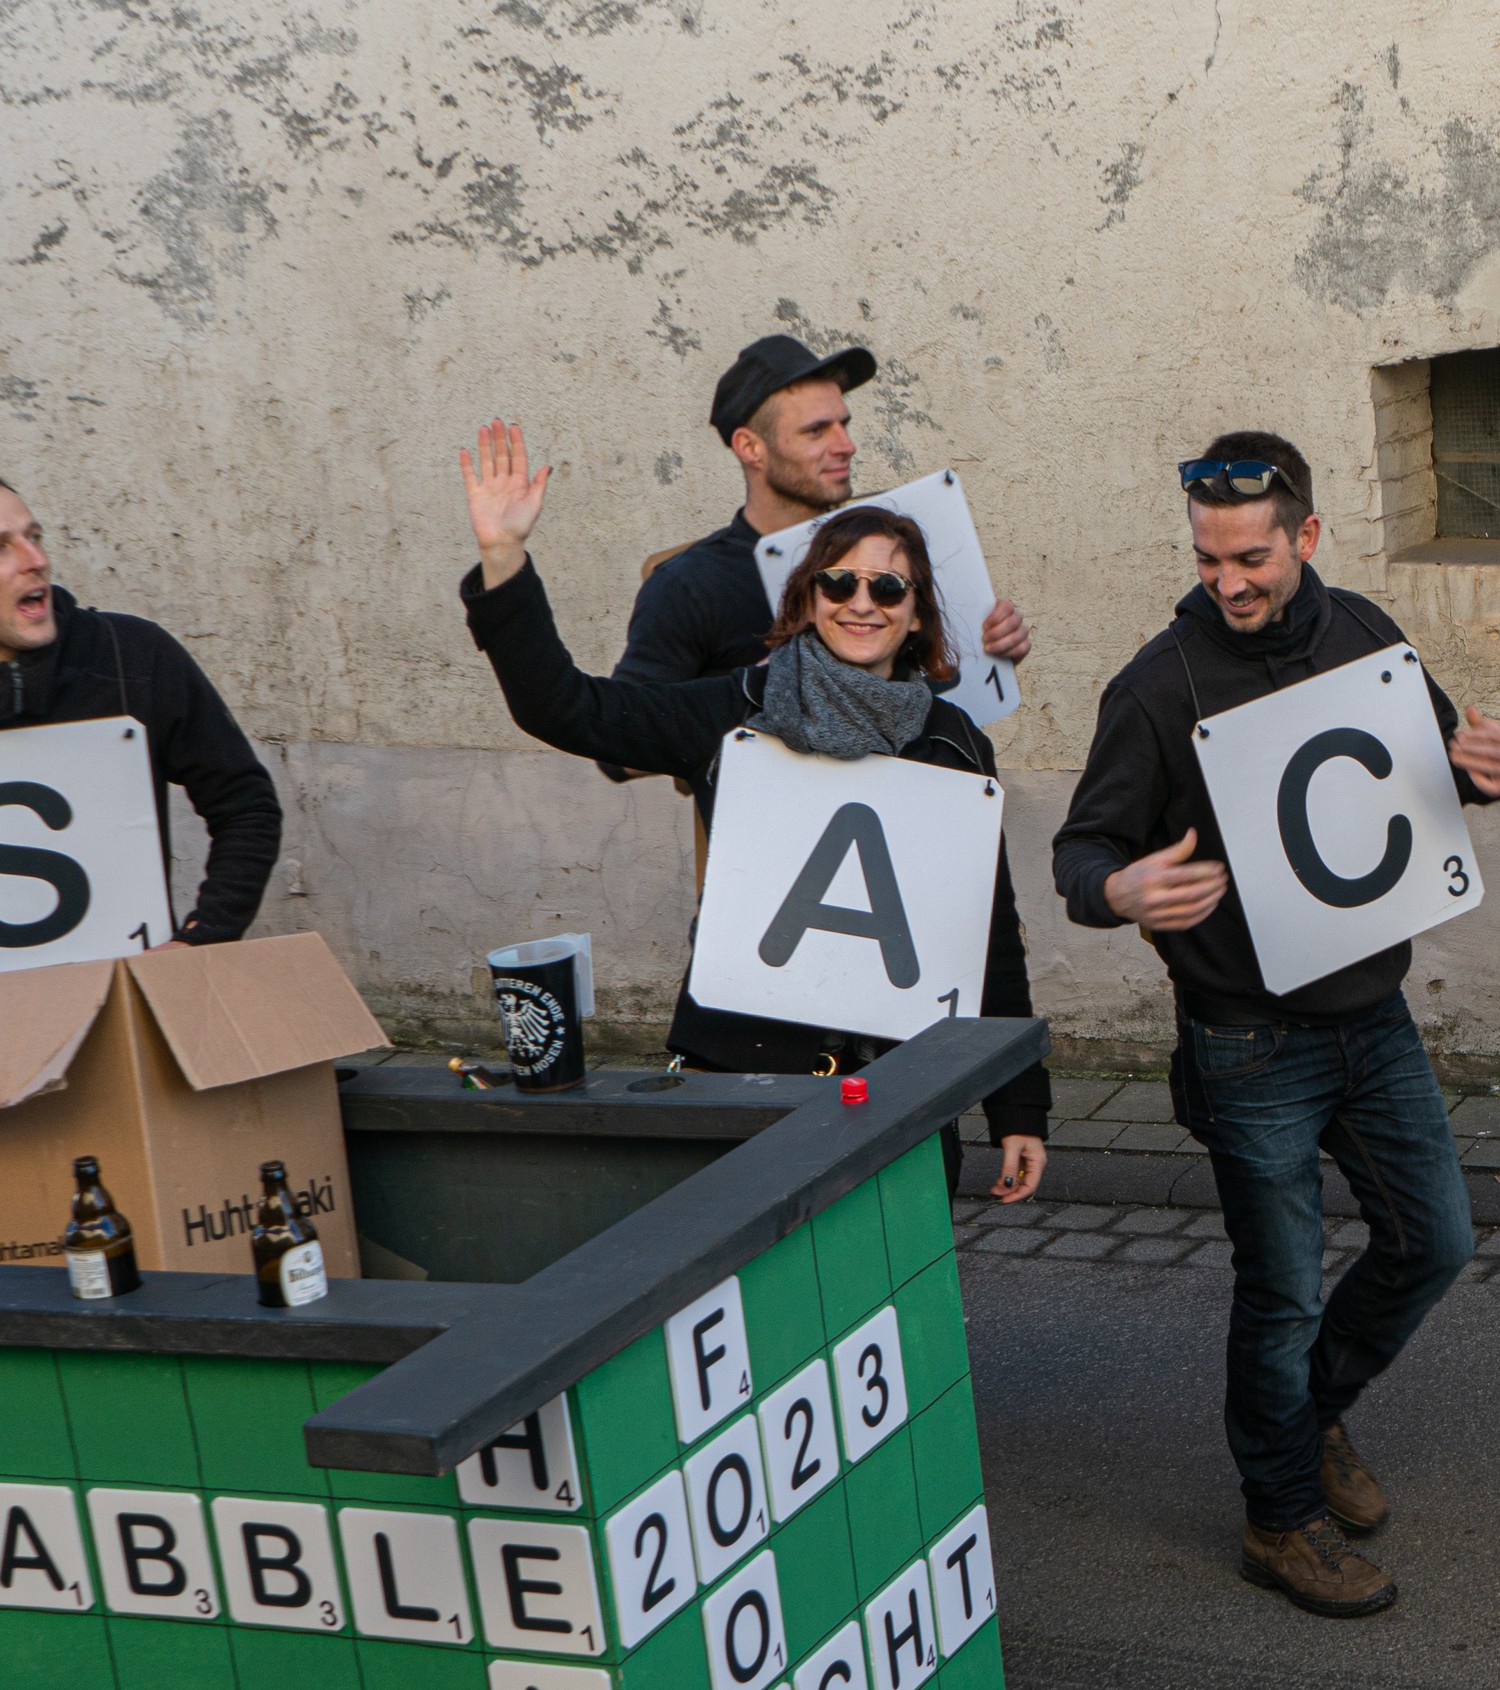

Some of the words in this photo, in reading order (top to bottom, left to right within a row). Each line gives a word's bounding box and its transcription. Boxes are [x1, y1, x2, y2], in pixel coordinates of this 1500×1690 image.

[984, 664, 1005, 703] 1
[1276, 727, 1413, 909] C
[1443, 855, 1470, 897] 3
[0, 780, 91, 949] S
[128, 921, 152, 951] 1
[758, 802, 920, 990] A
[937, 987, 959, 1018] 1
[539, 991, 565, 1023] ENDE
[531, 1039, 565, 1074] HOSEN
[182, 1174, 336, 1247] Huhtaki
[692, 1307, 726, 1412] F
[554, 1479, 576, 1508] 4
